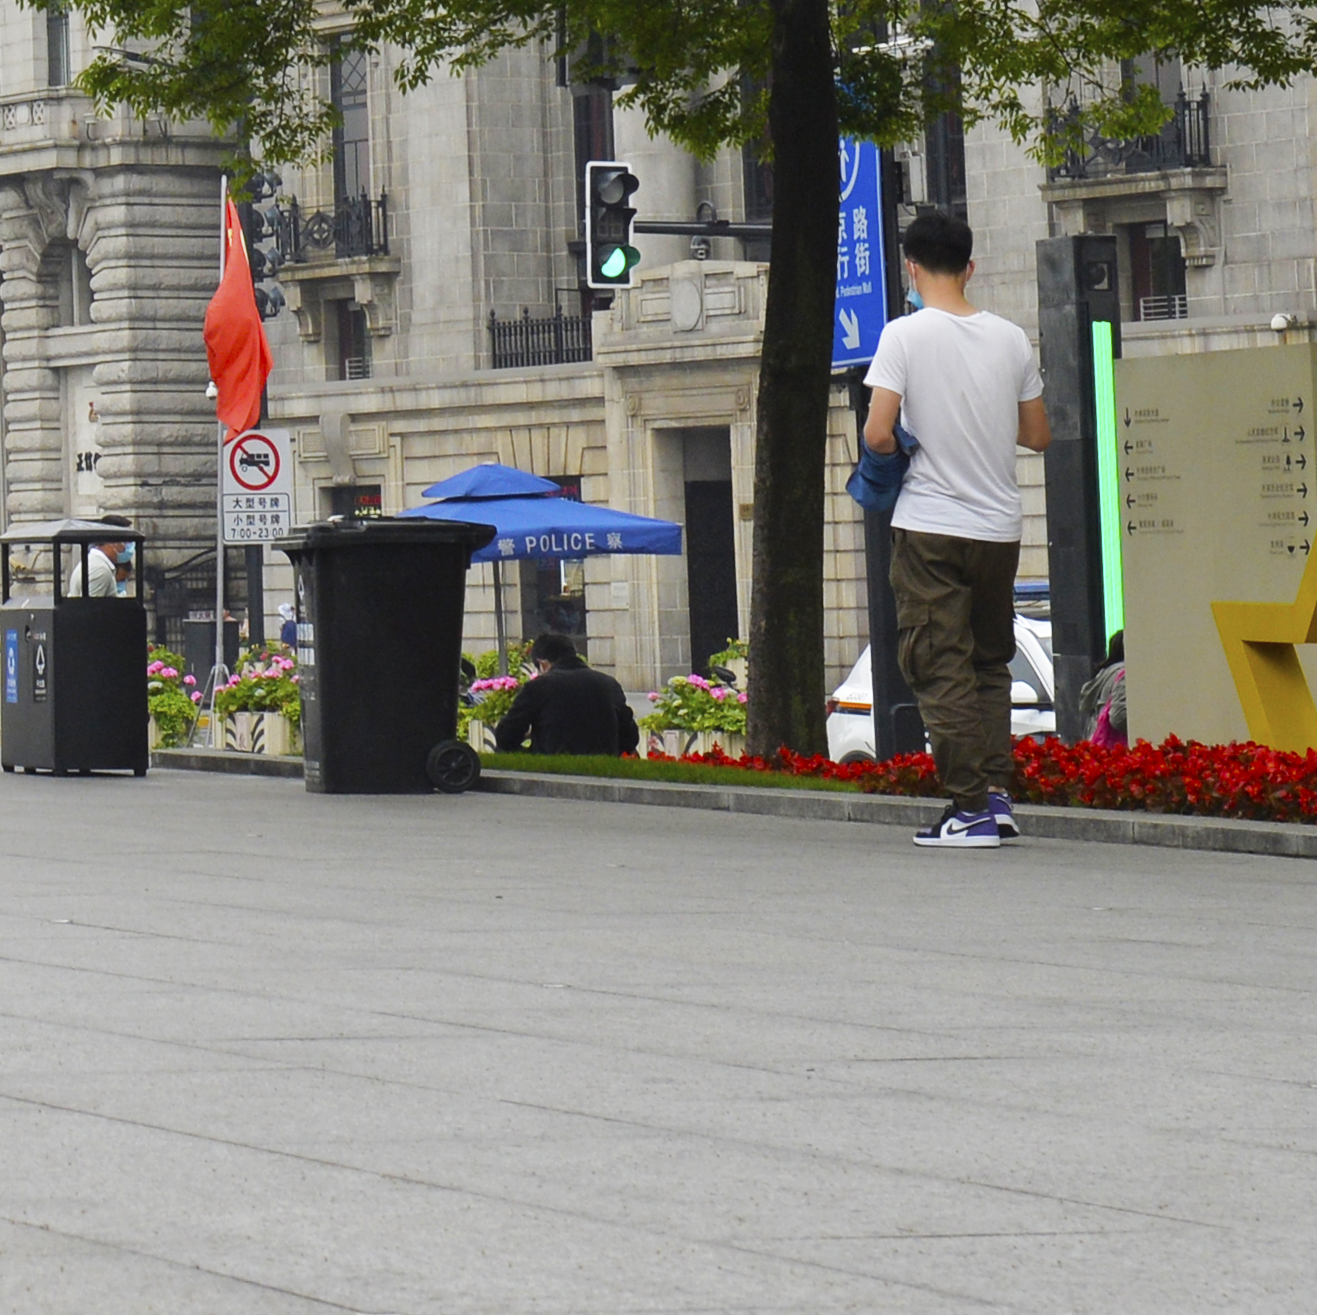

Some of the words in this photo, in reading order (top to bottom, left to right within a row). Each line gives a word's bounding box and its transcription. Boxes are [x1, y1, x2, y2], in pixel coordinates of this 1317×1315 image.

[232, 497, 280, 509] 大型号牌
[233, 513, 281, 526] 小型号牌
[498, 538, 515, 556] 警
[525, 533, 595, 554] POLICE
[606, 532, 623, 550] 察
